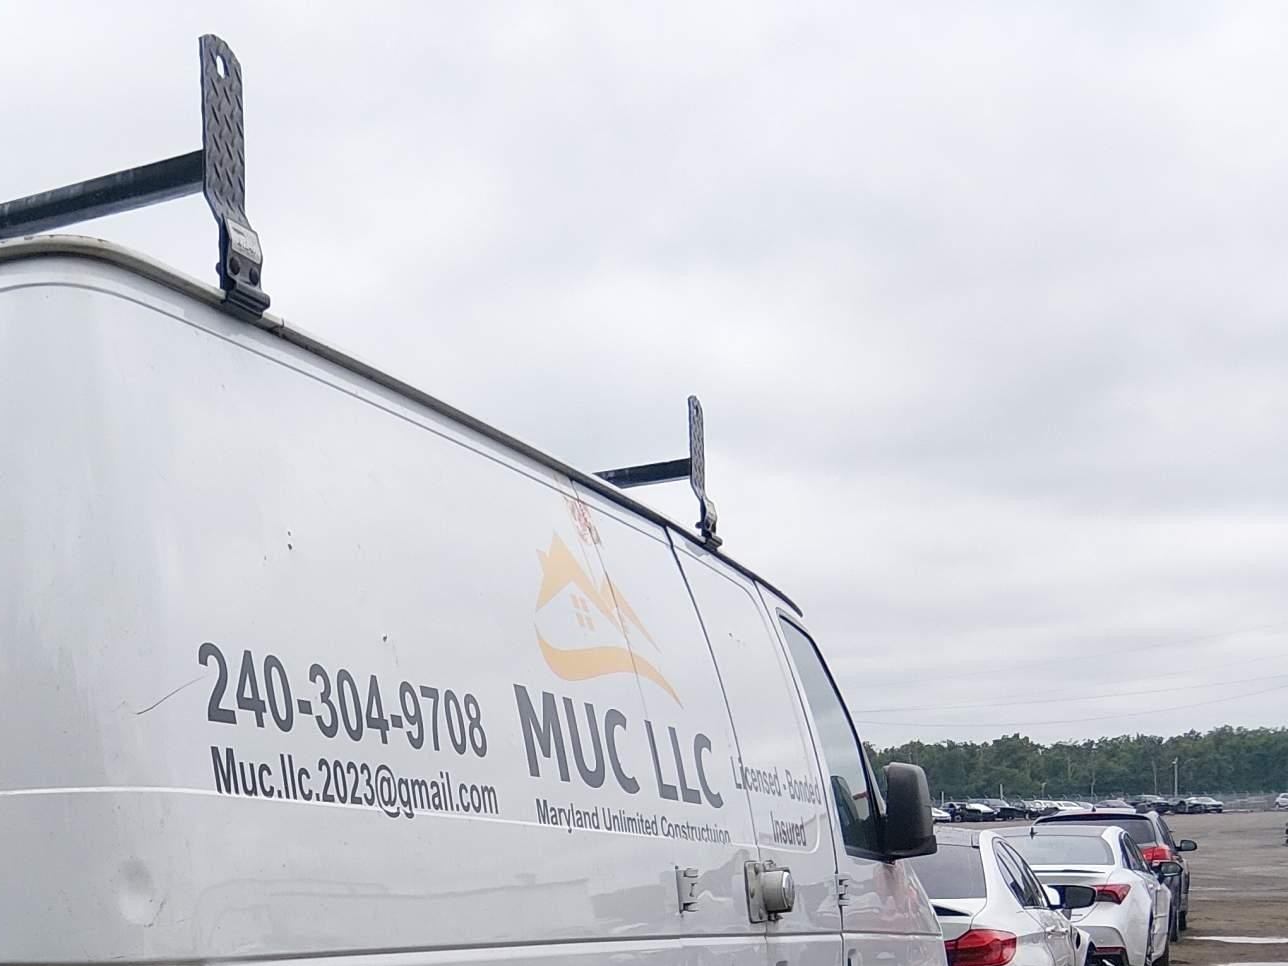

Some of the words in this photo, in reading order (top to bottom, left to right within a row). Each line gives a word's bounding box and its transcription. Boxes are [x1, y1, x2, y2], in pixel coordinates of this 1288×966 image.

[198, 642, 488, 758] 240-304-9708
[513, 683, 641, 795] MUC
[644, 719, 725, 809] LLC
[210, 745, 499, 819] Muc.llc.2023@gmail.com
[785, 768, 822, 805] Bonded
[536, 798, 600, 834] Maryland
[602, 807, 659, 837] Unlimited
[770, 810, 807, 847] Insured
